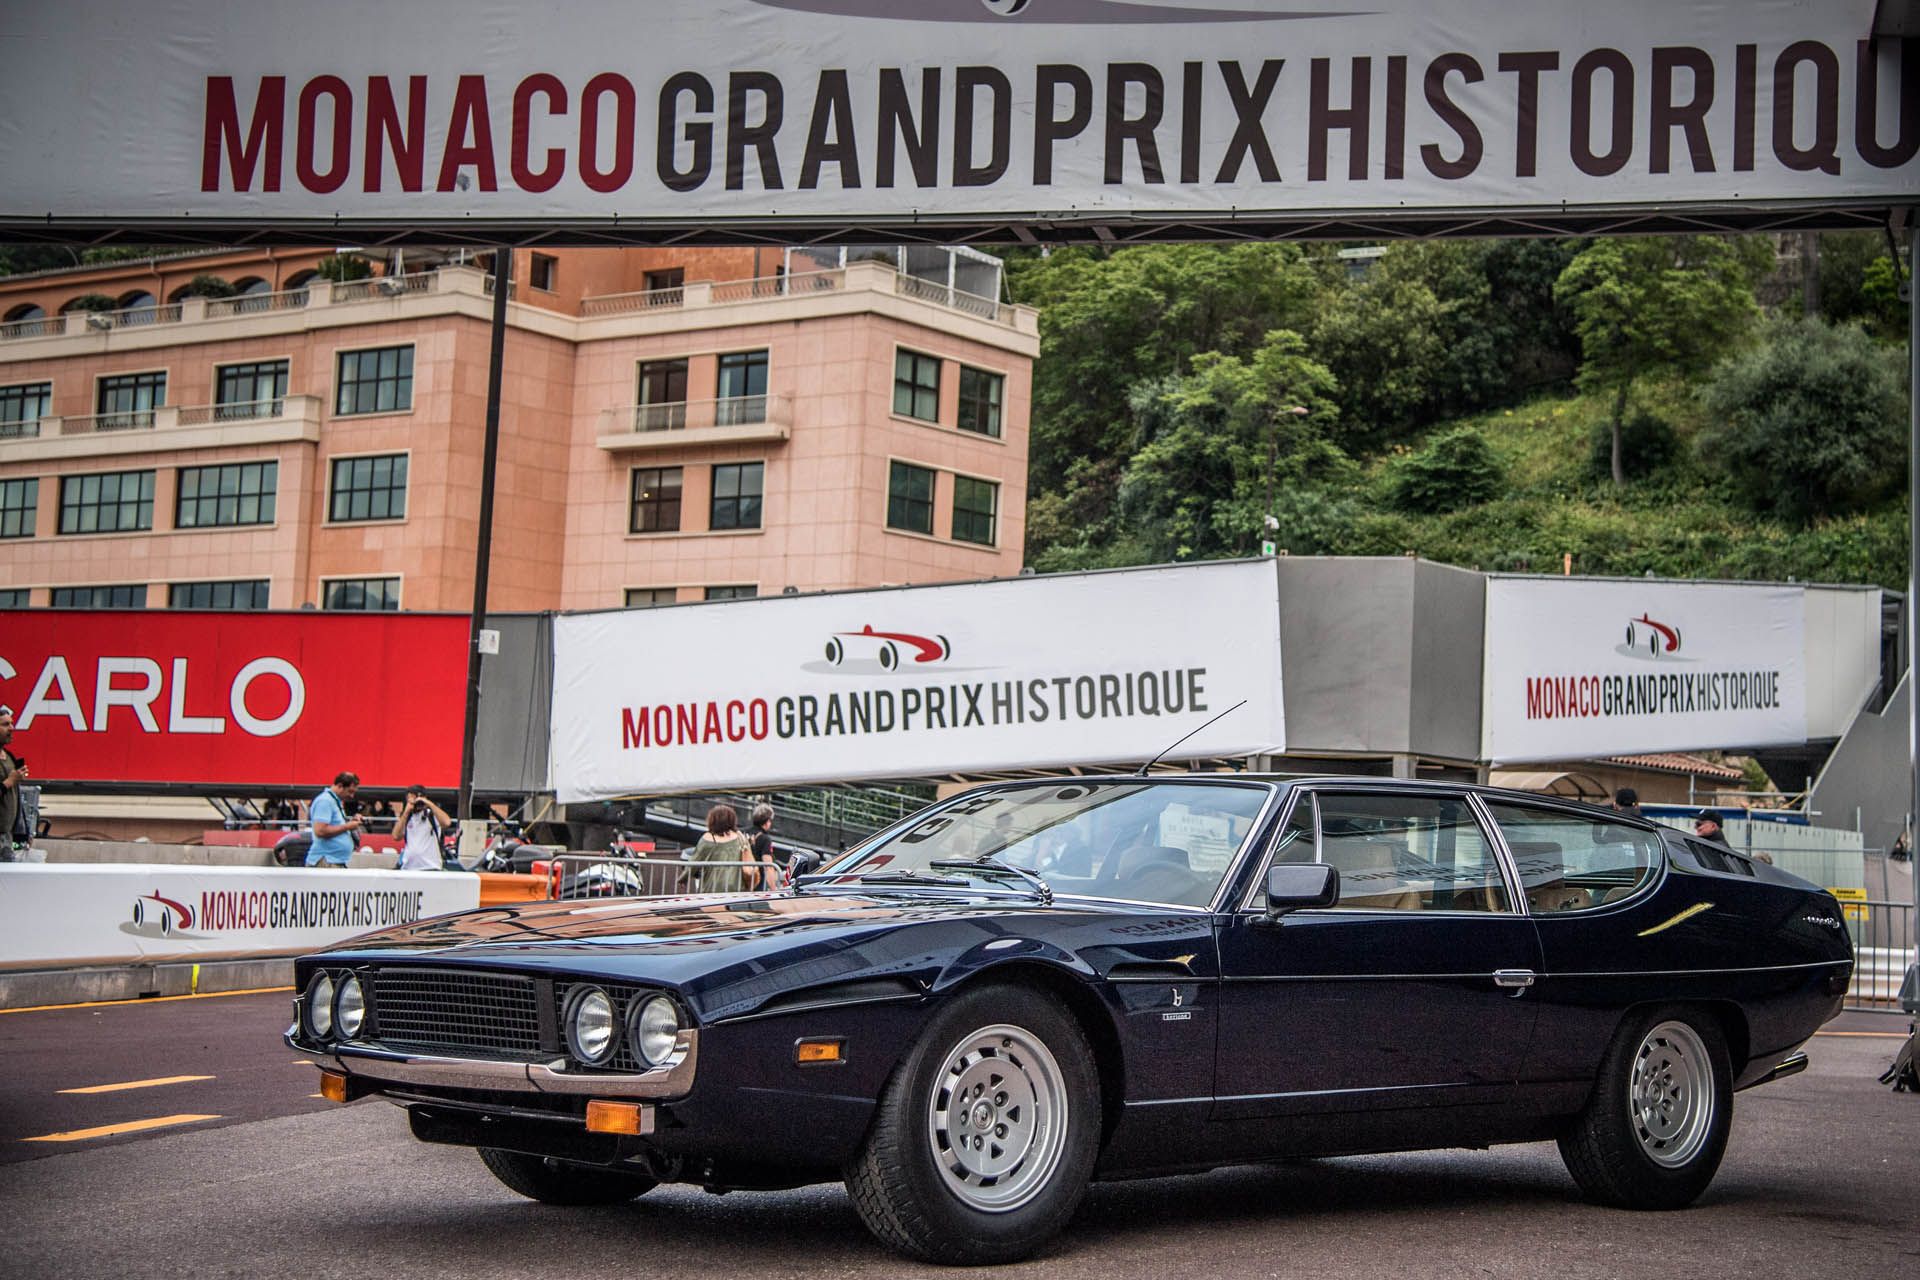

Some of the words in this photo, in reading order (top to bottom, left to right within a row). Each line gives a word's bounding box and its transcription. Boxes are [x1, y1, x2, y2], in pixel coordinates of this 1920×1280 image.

[200, 72, 636, 194] MONACO
[0, 655, 306, 737] ARLO
[621, 697, 769, 750] MONACO
[991, 667, 1208, 725] HISTORIQUE
[1526, 675, 1601, 720] MONACO
[1696, 671, 1780, 712] HISTORIQUE
[200, 891, 268, 931] MONACO
